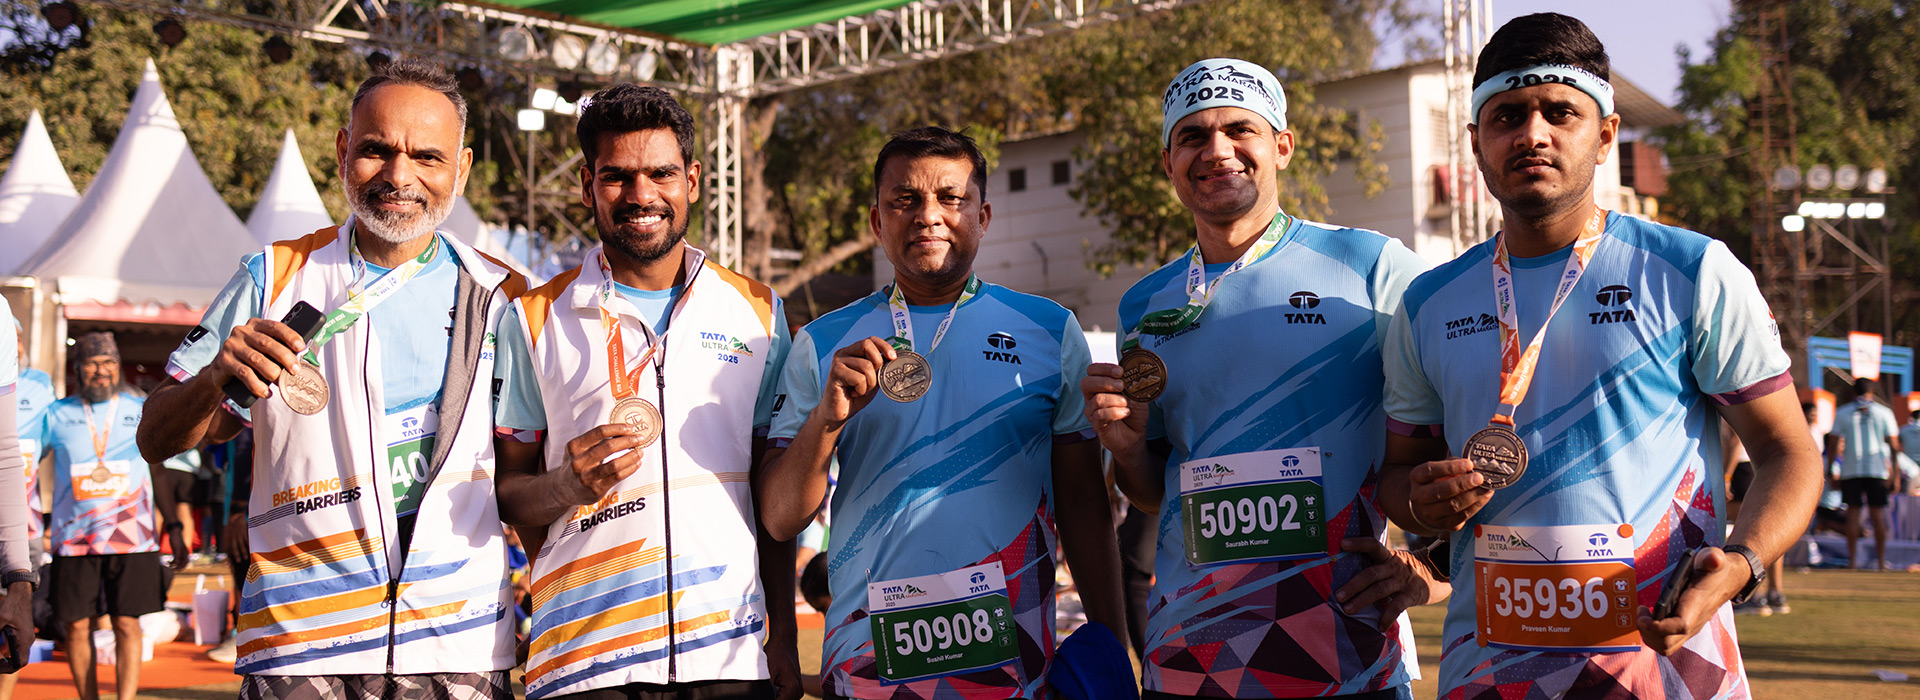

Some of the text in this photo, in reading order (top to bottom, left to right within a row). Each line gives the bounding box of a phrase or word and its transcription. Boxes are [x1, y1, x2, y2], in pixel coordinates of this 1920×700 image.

[1185, 86, 1245, 109] 2025
[1218, 74, 1278, 112] MARATHON
[1284, 313, 1327, 325] TATA
[1589, 310, 1637, 325] TATA
[1445, 316, 1474, 330] TATA
[700, 332, 727, 342] TATA
[1447, 326, 1476, 340] ULTRA
[1154, 333, 1175, 348] ULTRA
[701, 341, 729, 351] ULTRA
[718, 353, 739, 364] 2025
[982, 351, 1022, 365] TATA
[402, 428, 424, 437] TATA
[1475, 443, 1496, 452] TATA
[1473, 449, 1496, 459] ULTRA
[1192, 465, 1211, 474] TATA
[1279, 469, 1303, 477] TATA
[1193, 473, 1213, 481] ULTRA
[272, 477, 341, 507] BREAKING
[296, 486, 361, 515] BARRIERS
[580, 497, 646, 533] BARRIERS
[1200, 494, 1301, 539] 50902
[1487, 533, 1506, 542] TATA
[1488, 543, 1508, 551] ULTRA
[1586, 549, 1614, 557] TATA
[882, 586, 903, 594] TATA
[969, 584, 991, 594] TATA
[884, 593, 905, 601] ULTRA
[1494, 576, 1609, 619] 35936
[893, 608, 994, 656] 50908
[1521, 624, 1571, 633] Praveen Kumar
[944, 653, 964, 661] Kumar
